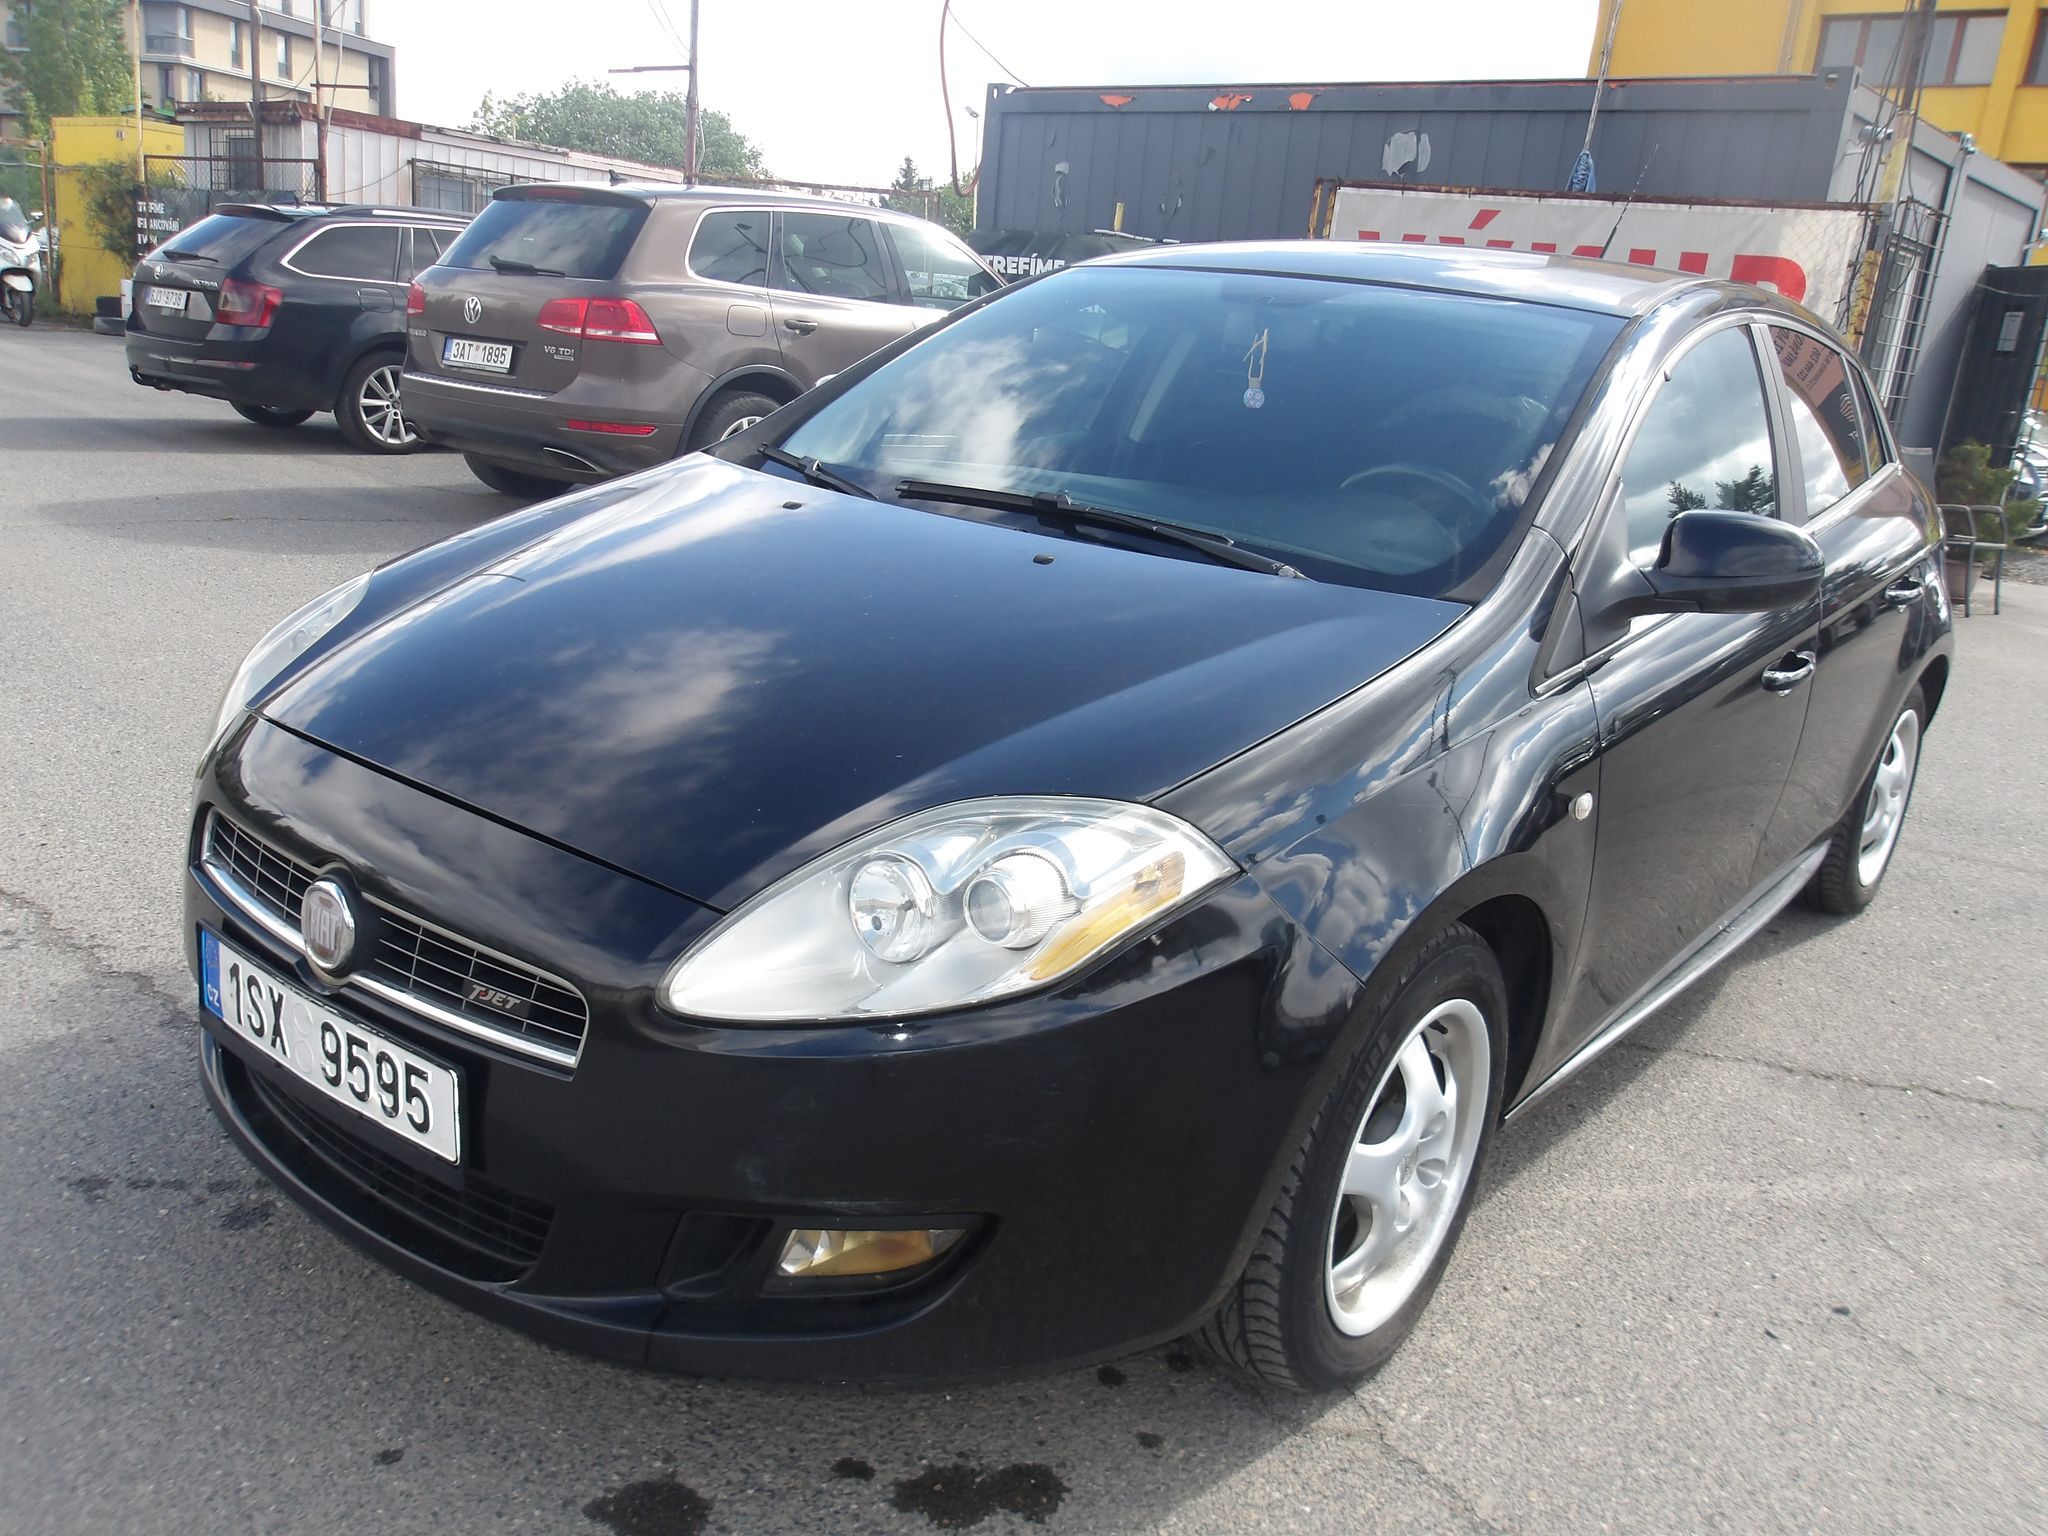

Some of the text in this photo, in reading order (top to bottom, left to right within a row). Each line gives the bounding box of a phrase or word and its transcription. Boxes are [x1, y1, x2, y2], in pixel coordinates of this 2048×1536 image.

[137, 217, 180, 232] FIANCOVÁNÍ
[453, 342, 508, 365] 3AT 1895
[543, 345, 575, 356] V6 TDI
[310, 903, 340, 951] FIAT
[207, 984, 221, 1007] CZ
[229, 962, 434, 1135] 1SX 9595
